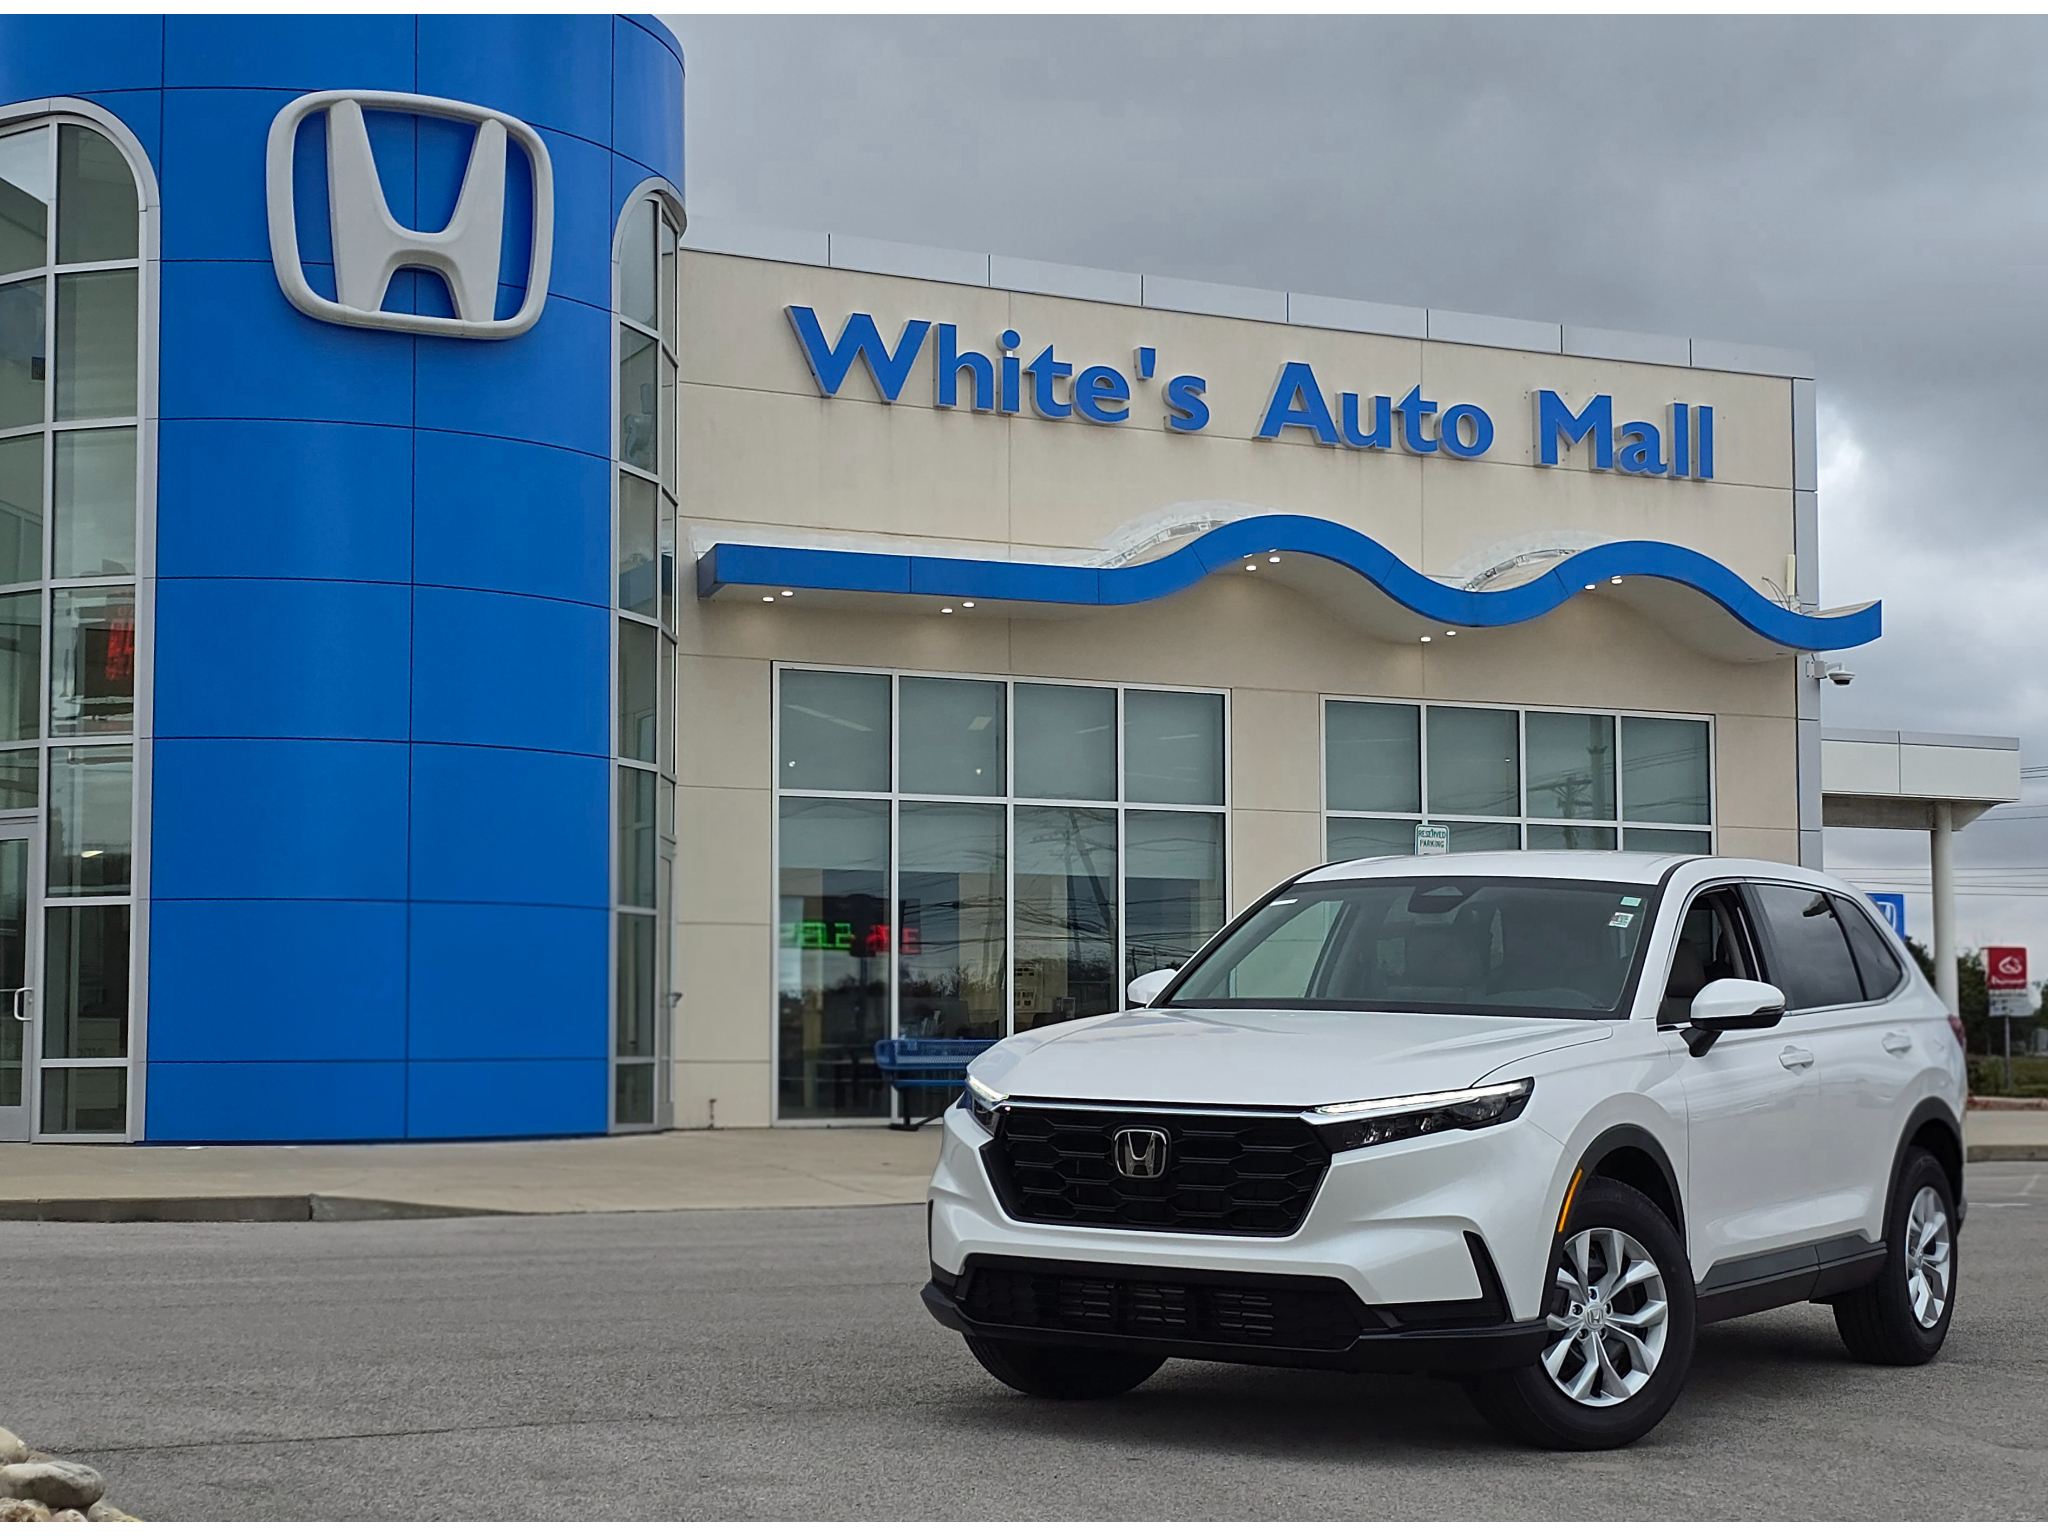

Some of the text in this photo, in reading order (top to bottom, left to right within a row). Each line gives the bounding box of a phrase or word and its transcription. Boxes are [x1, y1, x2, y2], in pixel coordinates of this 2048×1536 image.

[785, 304, 1715, 480] White's Auto Mall
[1418, 829, 1447, 839] RESERVED
[1419, 839, 1445, 848] PARKING
